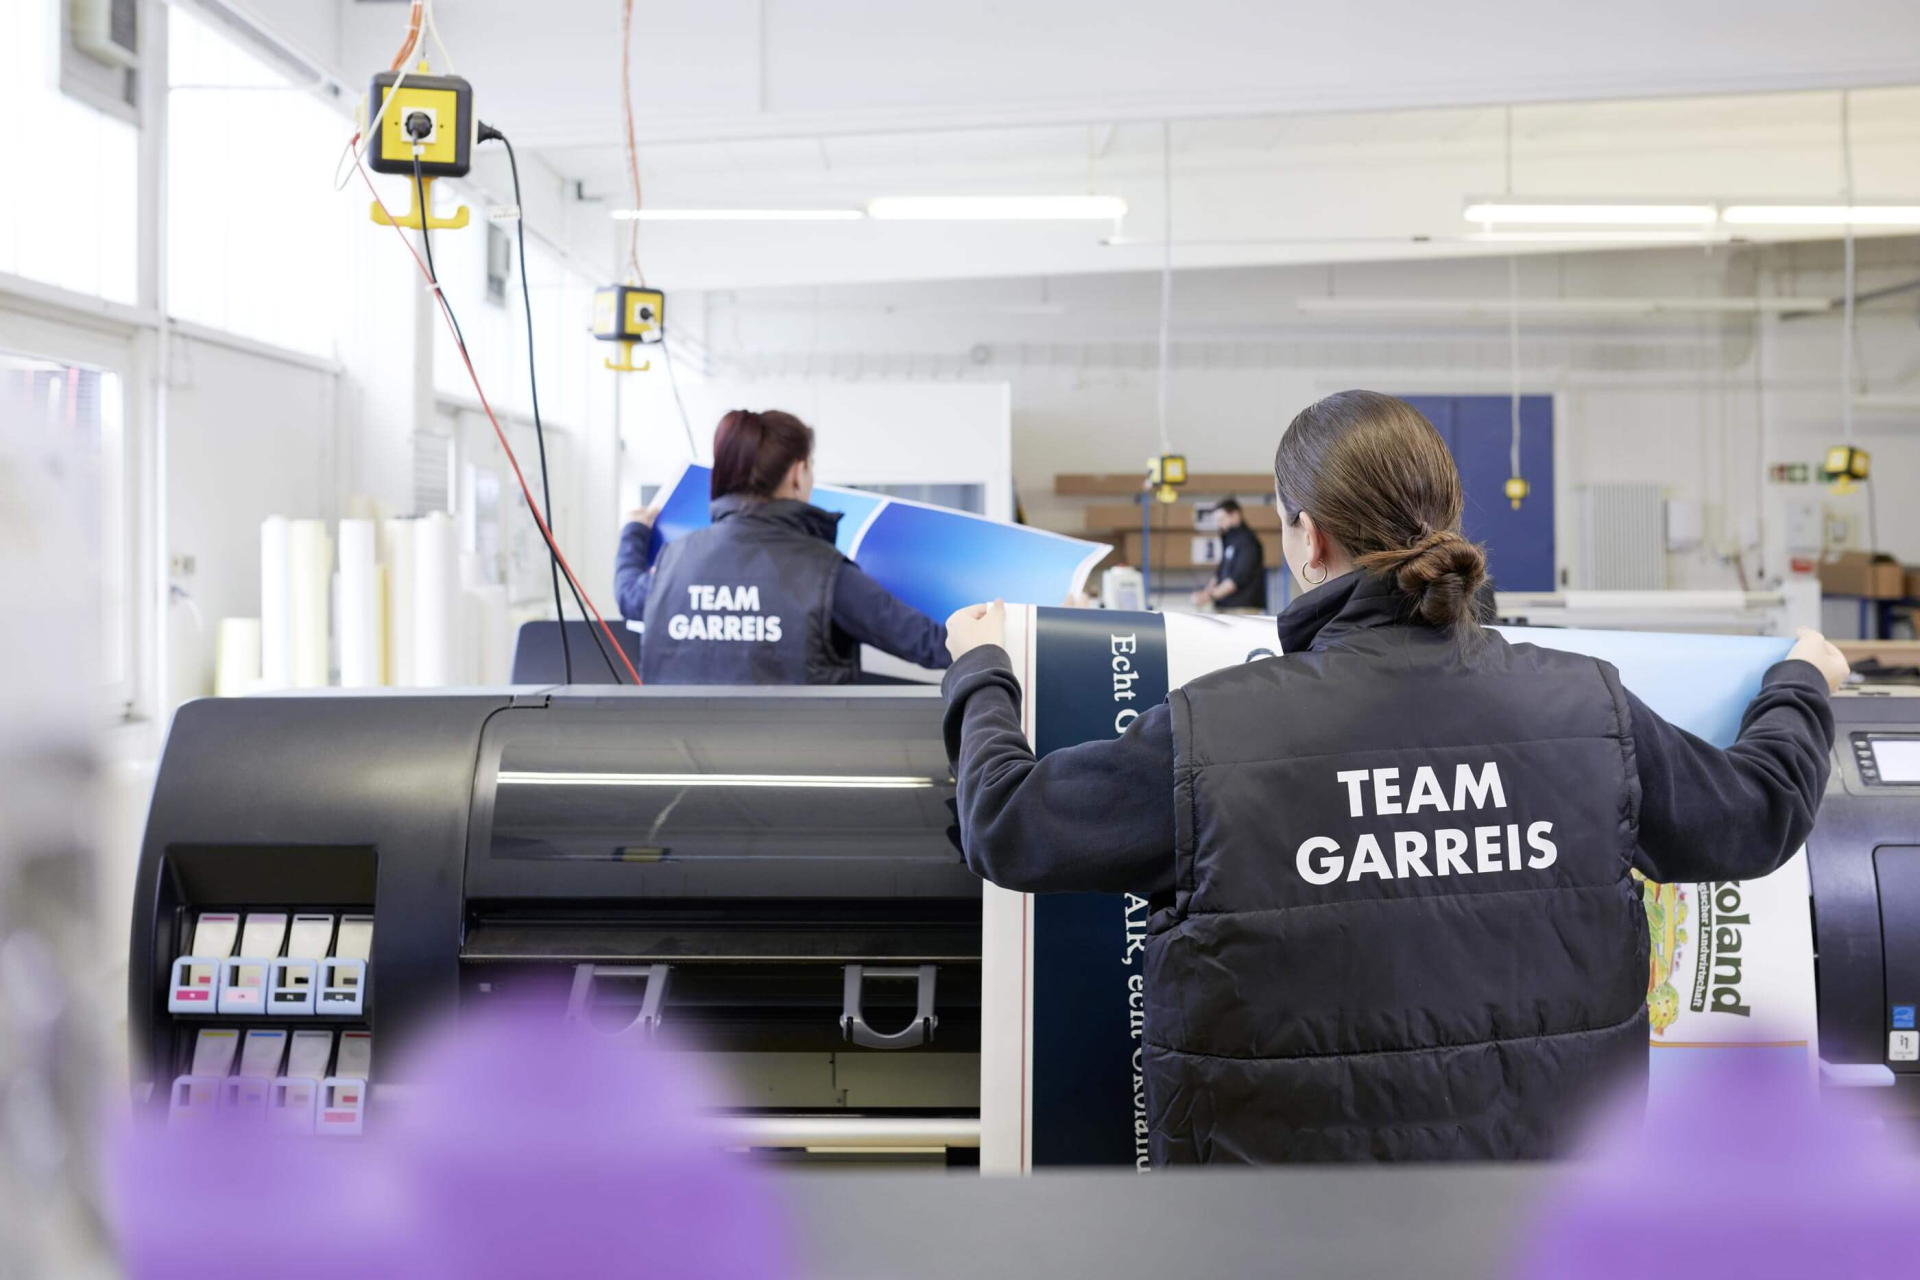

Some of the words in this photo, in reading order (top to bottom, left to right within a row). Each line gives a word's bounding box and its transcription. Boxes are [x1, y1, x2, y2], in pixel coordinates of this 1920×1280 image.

[688, 585, 760, 611] TEAM
[668, 614, 782, 642] GARREIS
[1111, 633, 1139, 702] Echt
[1337, 762, 1507, 817] TEAM
[1296, 821, 1557, 885] GARREIS
[1698, 882, 1711, 924] gischer
[1693, 926, 1711, 1008] Landwirtschaft
